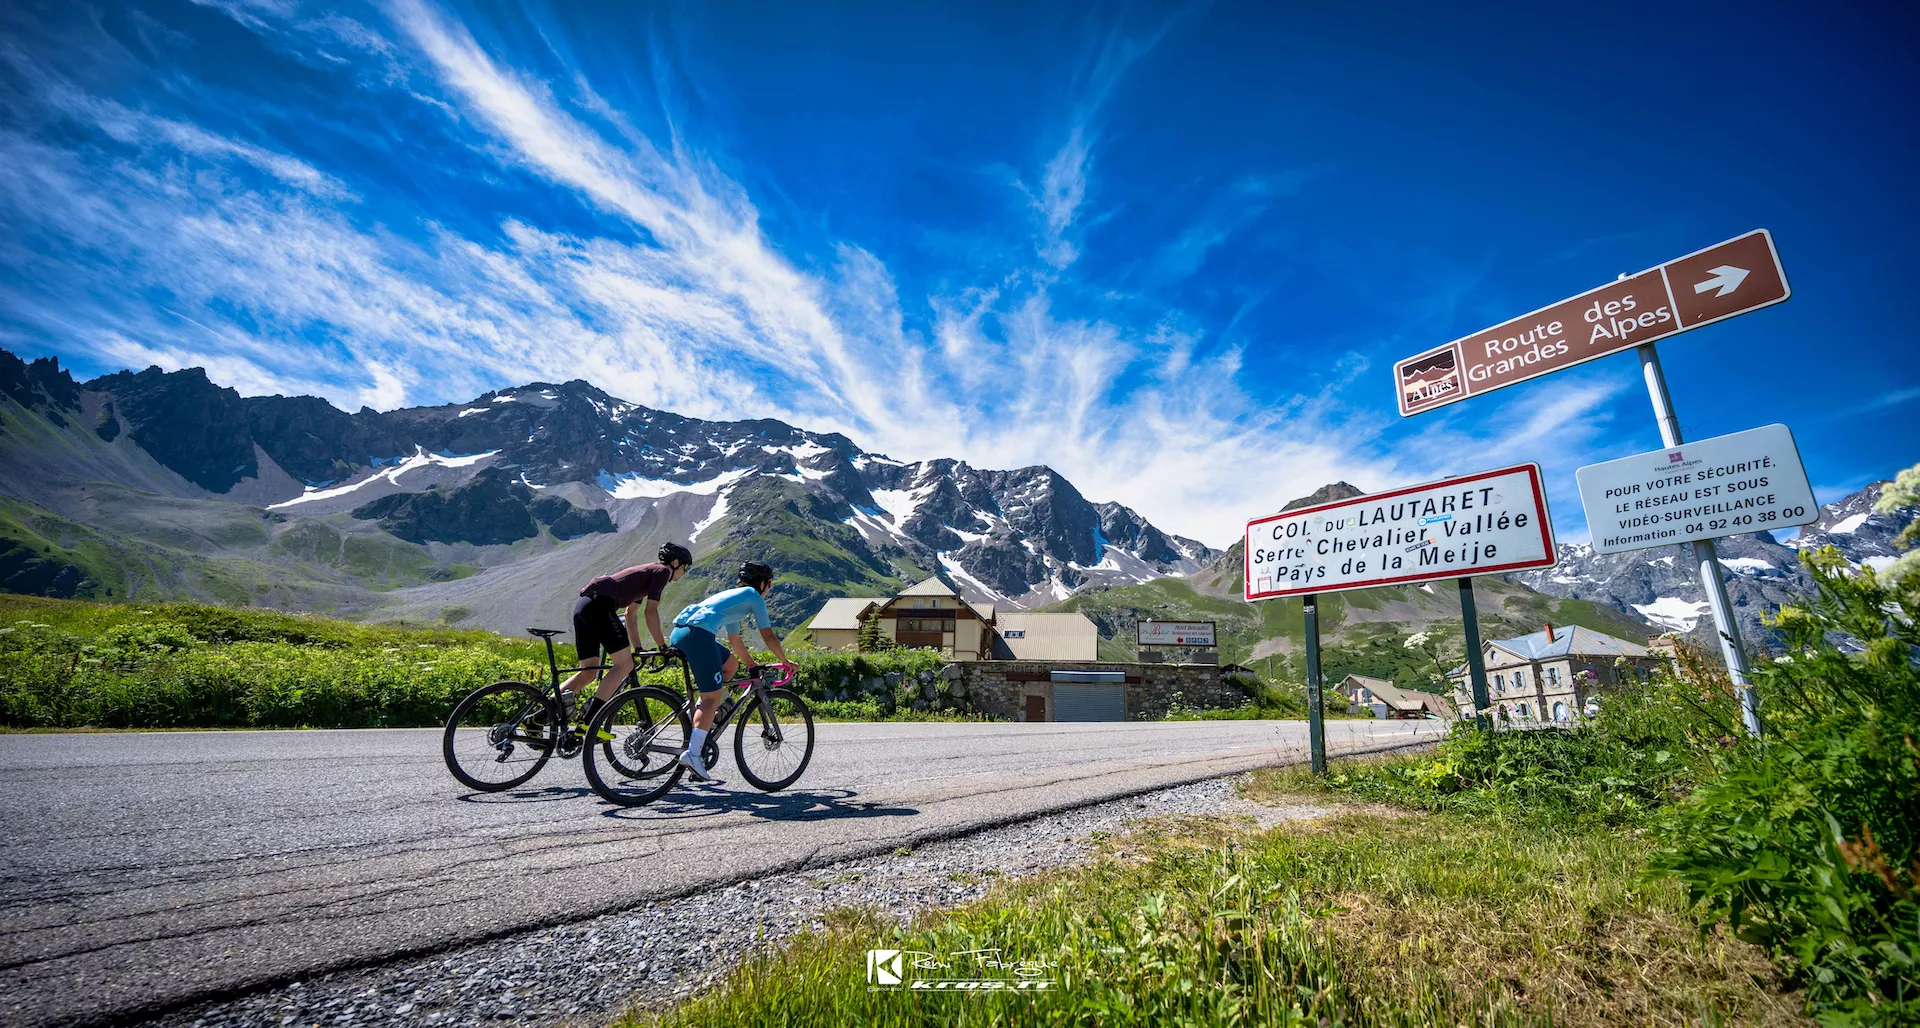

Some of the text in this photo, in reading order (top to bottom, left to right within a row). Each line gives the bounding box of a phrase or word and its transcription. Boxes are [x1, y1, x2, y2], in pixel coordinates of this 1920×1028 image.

[1467, 305, 1672, 383] Grandes Alpes
[1484, 293, 1637, 358] Route des
[1411, 380, 1454, 401] Alpes
[1605, 484, 1641, 499] POUR
[1646, 473, 1692, 491] VOTRE
[1697, 455, 1777, 481] SÉCURITÉ,
[1616, 476, 1769, 514] LE RÉSEAU EST SOUS
[1272, 519, 1311, 541] COL
[1325, 519, 1345, 532] DU
[1358, 487, 1494, 527] LAUTARET
[1603, 528, 1676, 547] Information
[1685, 522, 1704, 535] 04
[1709, 518, 1727, 530] 92
[1732, 514, 1753, 526] 40
[1757, 510, 1777, 523] 38
[1783, 506, 1804, 519] 00
[1619, 493, 1776, 530] VIDÉO-SURVEILLANCE
[1254, 547, 1305, 564] Serre
[1317, 526, 1428, 556] Chevalier
[1444, 512, 1528, 538] Vallée
[1276, 565, 1326, 583] Pays
[1341, 557, 1366, 575] de
[1381, 553, 1402, 570] la
[1418, 543, 1497, 566] Meije
